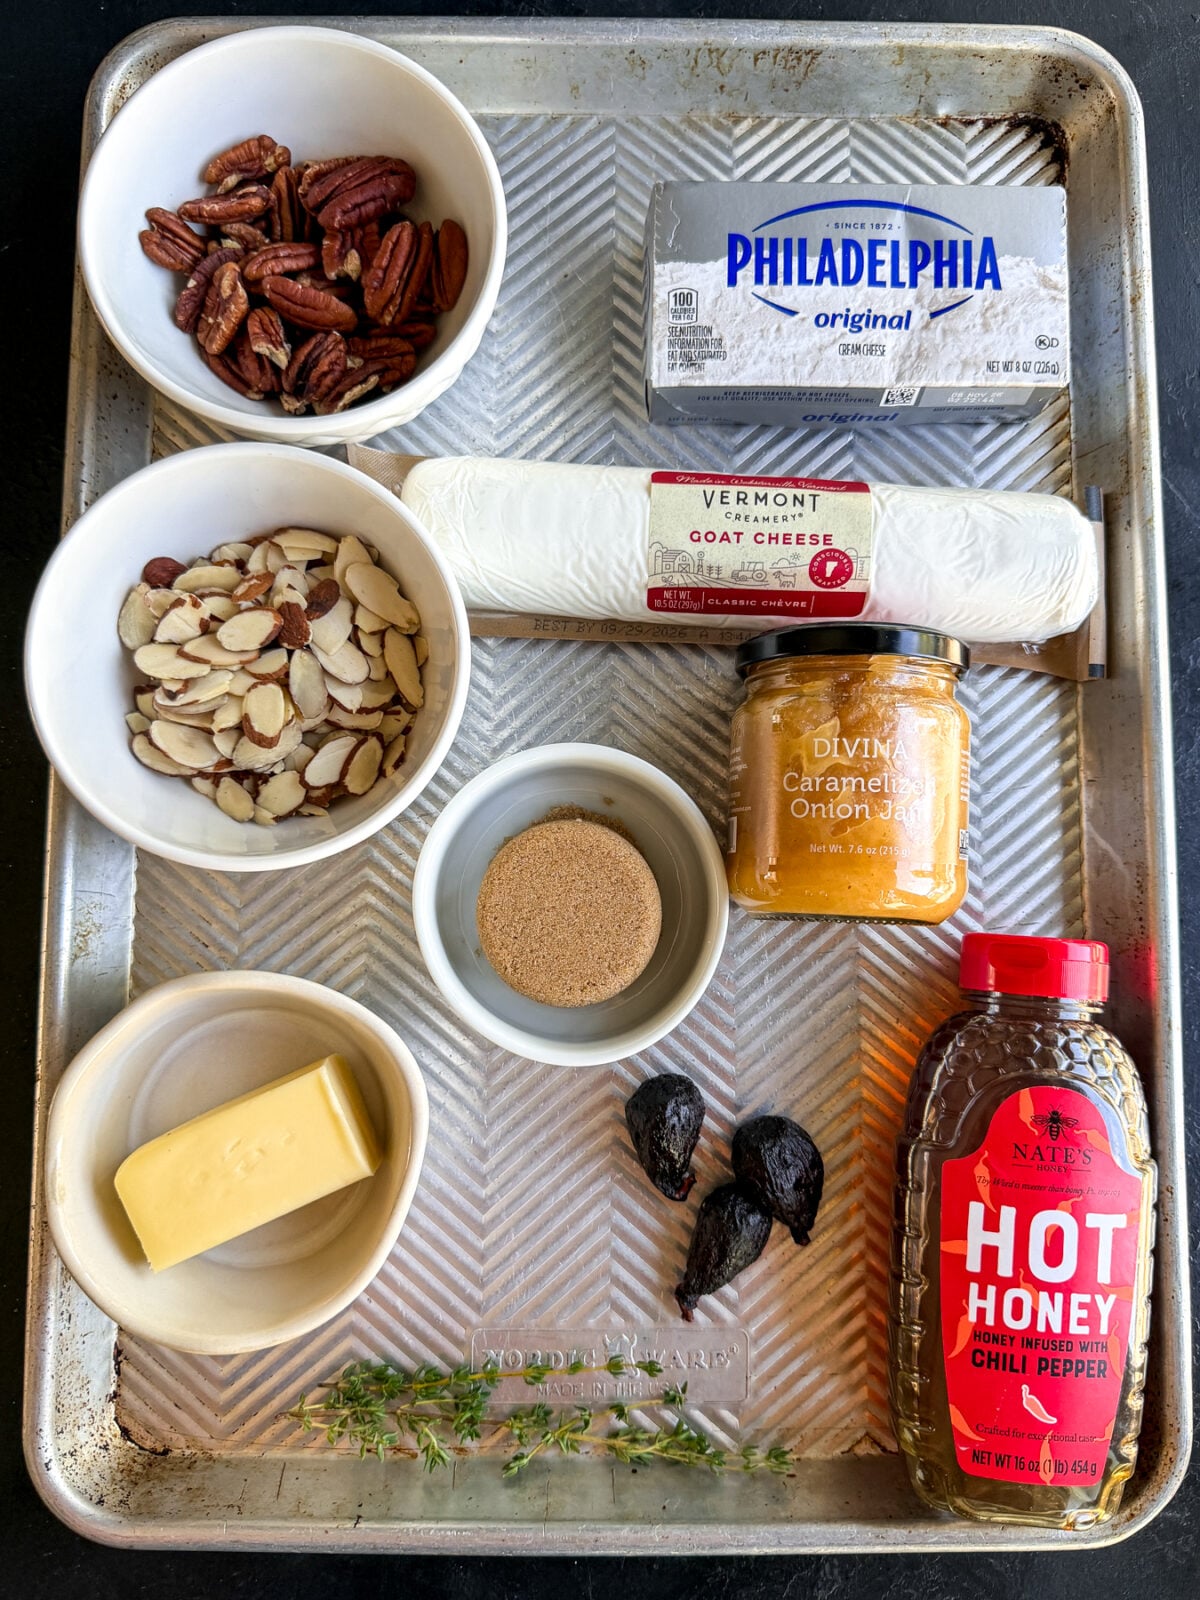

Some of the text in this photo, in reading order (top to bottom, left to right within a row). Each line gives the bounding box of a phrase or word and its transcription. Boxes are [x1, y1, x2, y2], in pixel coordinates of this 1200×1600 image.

[833, 222, 893, 231] SINCE 1872
[726, 232, 1003, 291] PHILADELPHIA
[672, 291, 693, 307] 100
[670, 307, 696, 315] CALORIES
[813, 307, 912, 334] original
[667, 325, 713, 338] SEE NUTRITION
[667, 338, 723, 350] INFORMATION FOR
[838, 343, 887, 357] CREAM CHEESE
[986, 361, 1000, 373] NET
[1002, 361, 1014, 373] WT
[1015, 361, 1021, 373] 8
[1022, 361, 1032, 373] OZ
[801, 412, 899, 424] original
[675, 475, 712, 485] Made
[797, 481, 848, 492] Vermont
[702, 489, 821, 513] VERMONT
[689, 530, 834, 546] GOAT CHEESE
[812, 551, 850, 573] CONSCIOUSLY
[814, 575, 846, 586] CRAFTED
[663, 590, 692, 600] NET WT.
[707, 598, 808, 608] CLASSIC CHÈVRE
[654, 599, 701, 611] 10.5 OZ (297g)
[533, 619, 569, 632] BEST
[576, 621, 596, 634] BY
[600, 624, 688, 640] 09/29/2026
[813, 737, 909, 760] DIVINA
[790, 798, 871, 820] Onion
[809, 843, 827, 854] Net
[828, 844, 846, 854] Wt.
[848, 845, 863, 855] 7.6
[865, 847, 878, 856] oz
[879, 844, 900, 857] (215
[1011, 1142, 1094, 1165] NATE'S
[1036, 1164, 1069, 1174] HONEY
[976, 1175, 991, 1187] Thy
[966, 1200, 1127, 1284] HOT
[967, 1282, 1117, 1335] HONEY
[972, 1330, 1108, 1353] HONEY INFUSED WITH
[482, 1348, 597, 1370] NORDIC
[971, 1348, 1108, 1378] CHILI PEPPER
[536, 1381, 585, 1397] MADE
[591, 1382, 606, 1397] IN
[614, 1381, 643, 1397] THE
[975, 1423, 1011, 1437] Crafted
[1011, 1429, 1025, 1439] for
[1027, 1432, 1077, 1444] exceptional
[972, 1449, 1097, 1476] NET WT 16 oz (1 lb) 454 g
